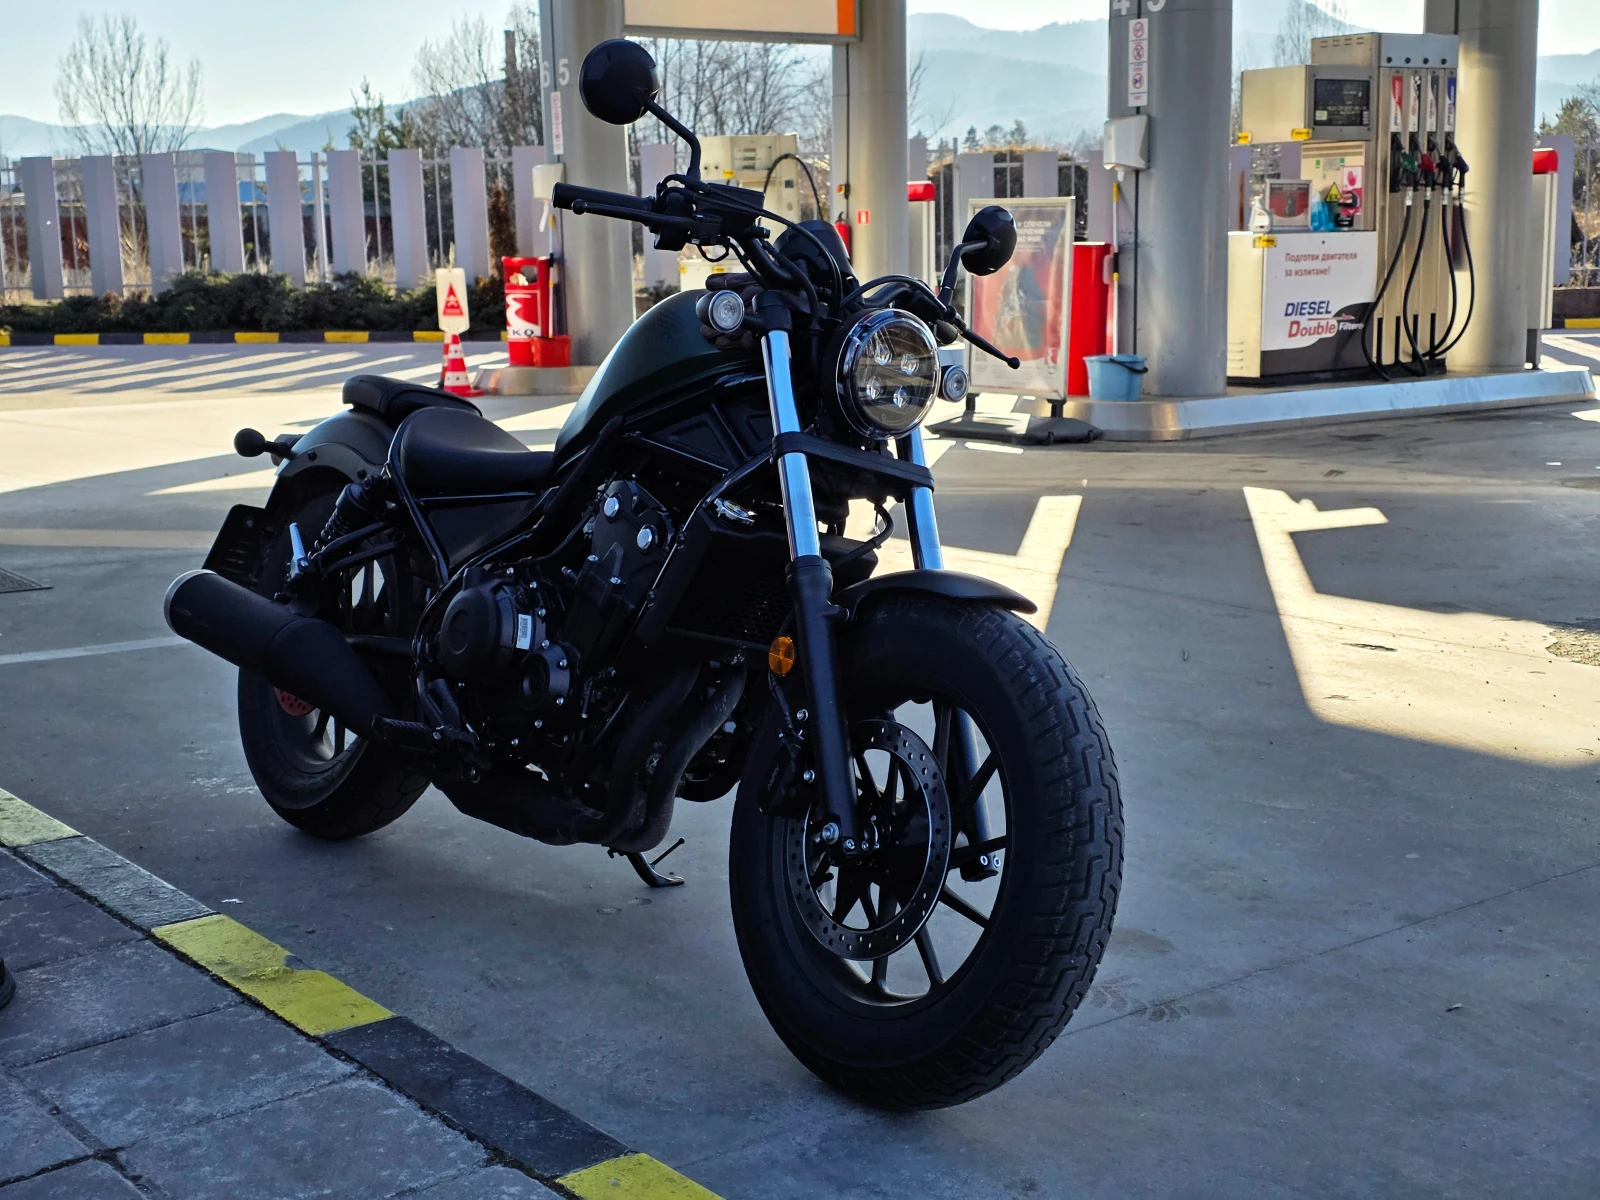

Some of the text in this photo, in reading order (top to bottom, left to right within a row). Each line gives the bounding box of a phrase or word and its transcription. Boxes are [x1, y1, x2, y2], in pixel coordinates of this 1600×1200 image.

[541, 61, 550, 88] 6
[558, 58, 570, 86] 5
[1285, 253, 1357, 263] Подготви двигателя
[1284, 269, 1293, 277] за
[1284, 301, 1332, 317] DIESEL
[509, 328, 534, 337] KO
[1288, 320, 1337, 338] Double
